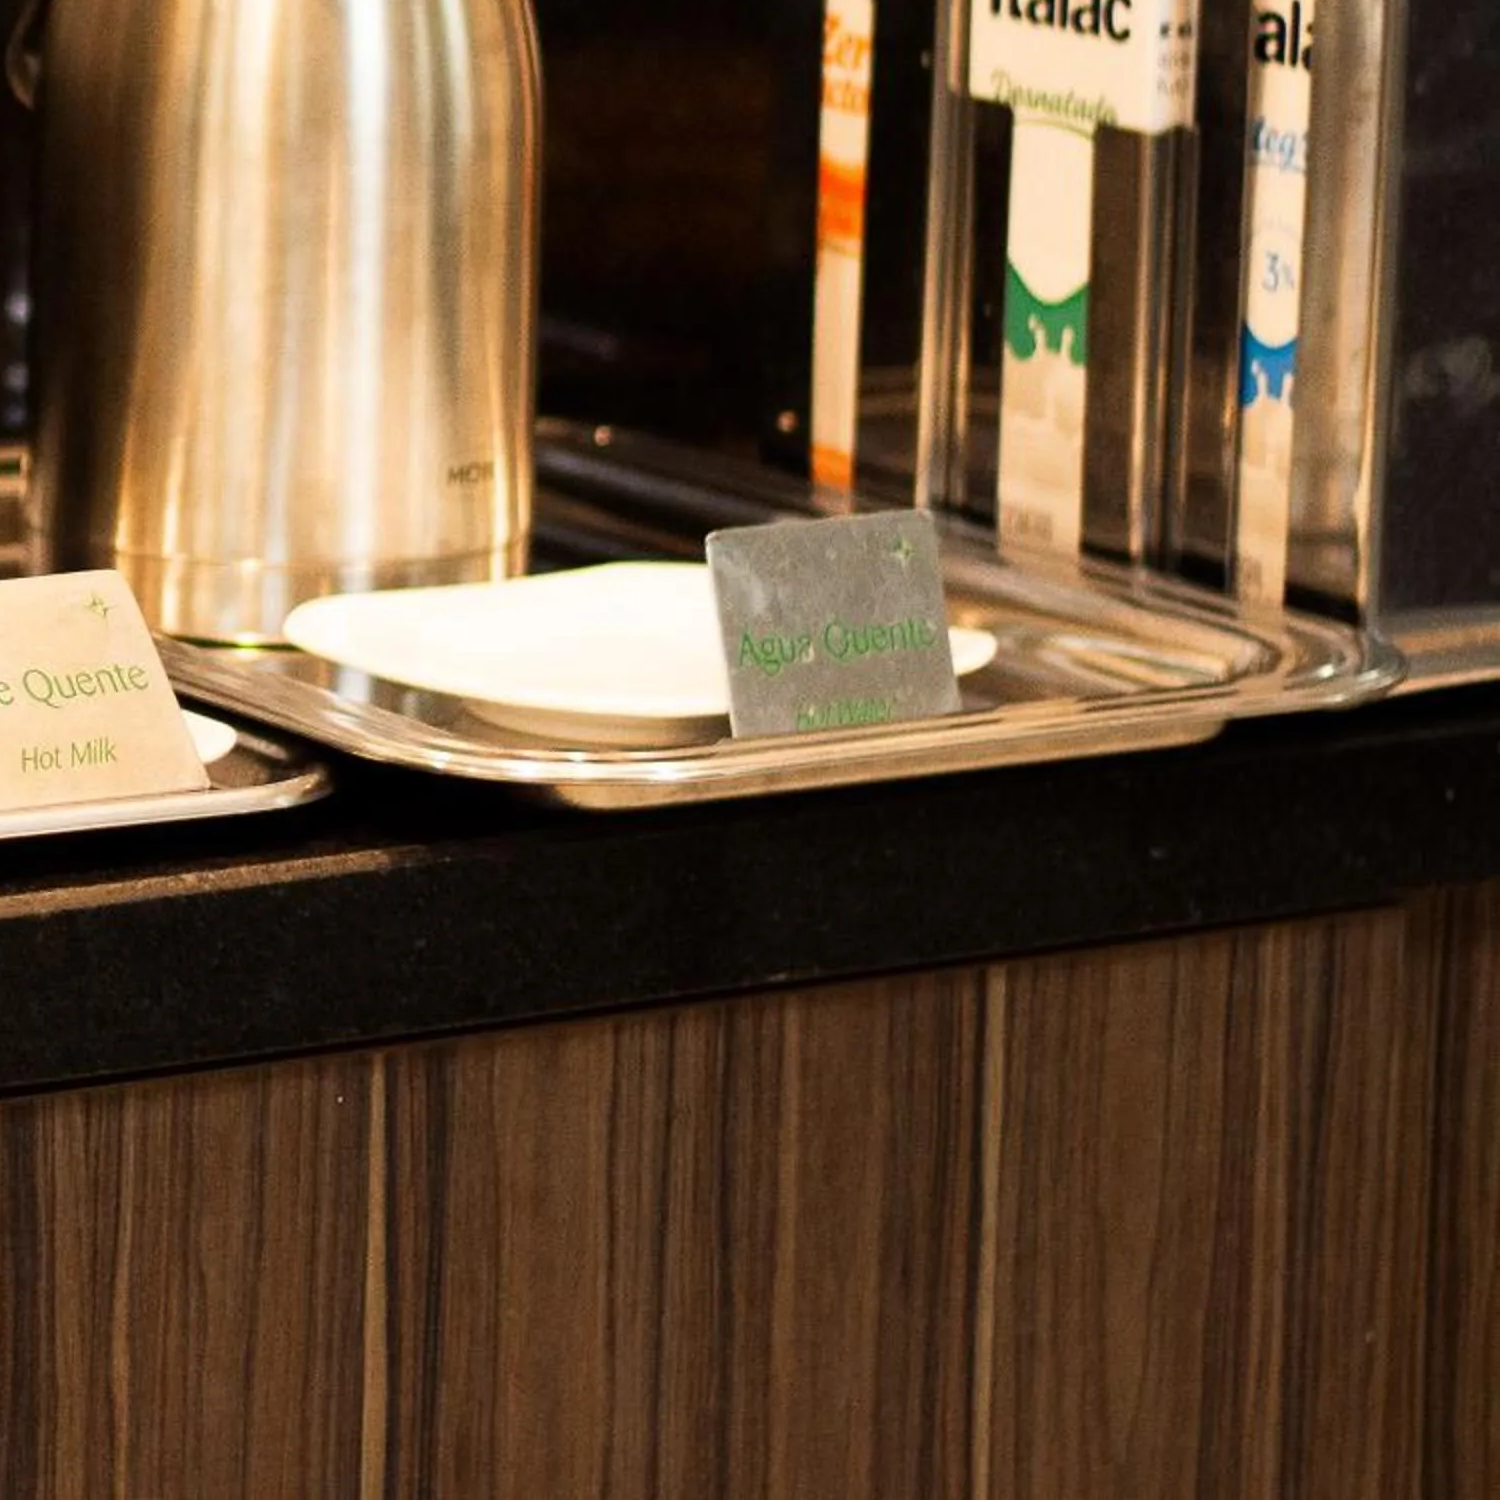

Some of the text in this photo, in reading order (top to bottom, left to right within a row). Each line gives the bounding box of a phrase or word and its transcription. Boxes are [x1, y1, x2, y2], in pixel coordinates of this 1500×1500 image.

[823, 616, 938, 664] Quente
[22, 663, 150, 709] Quente
[21, 737, 118, 774] Hot Milk
